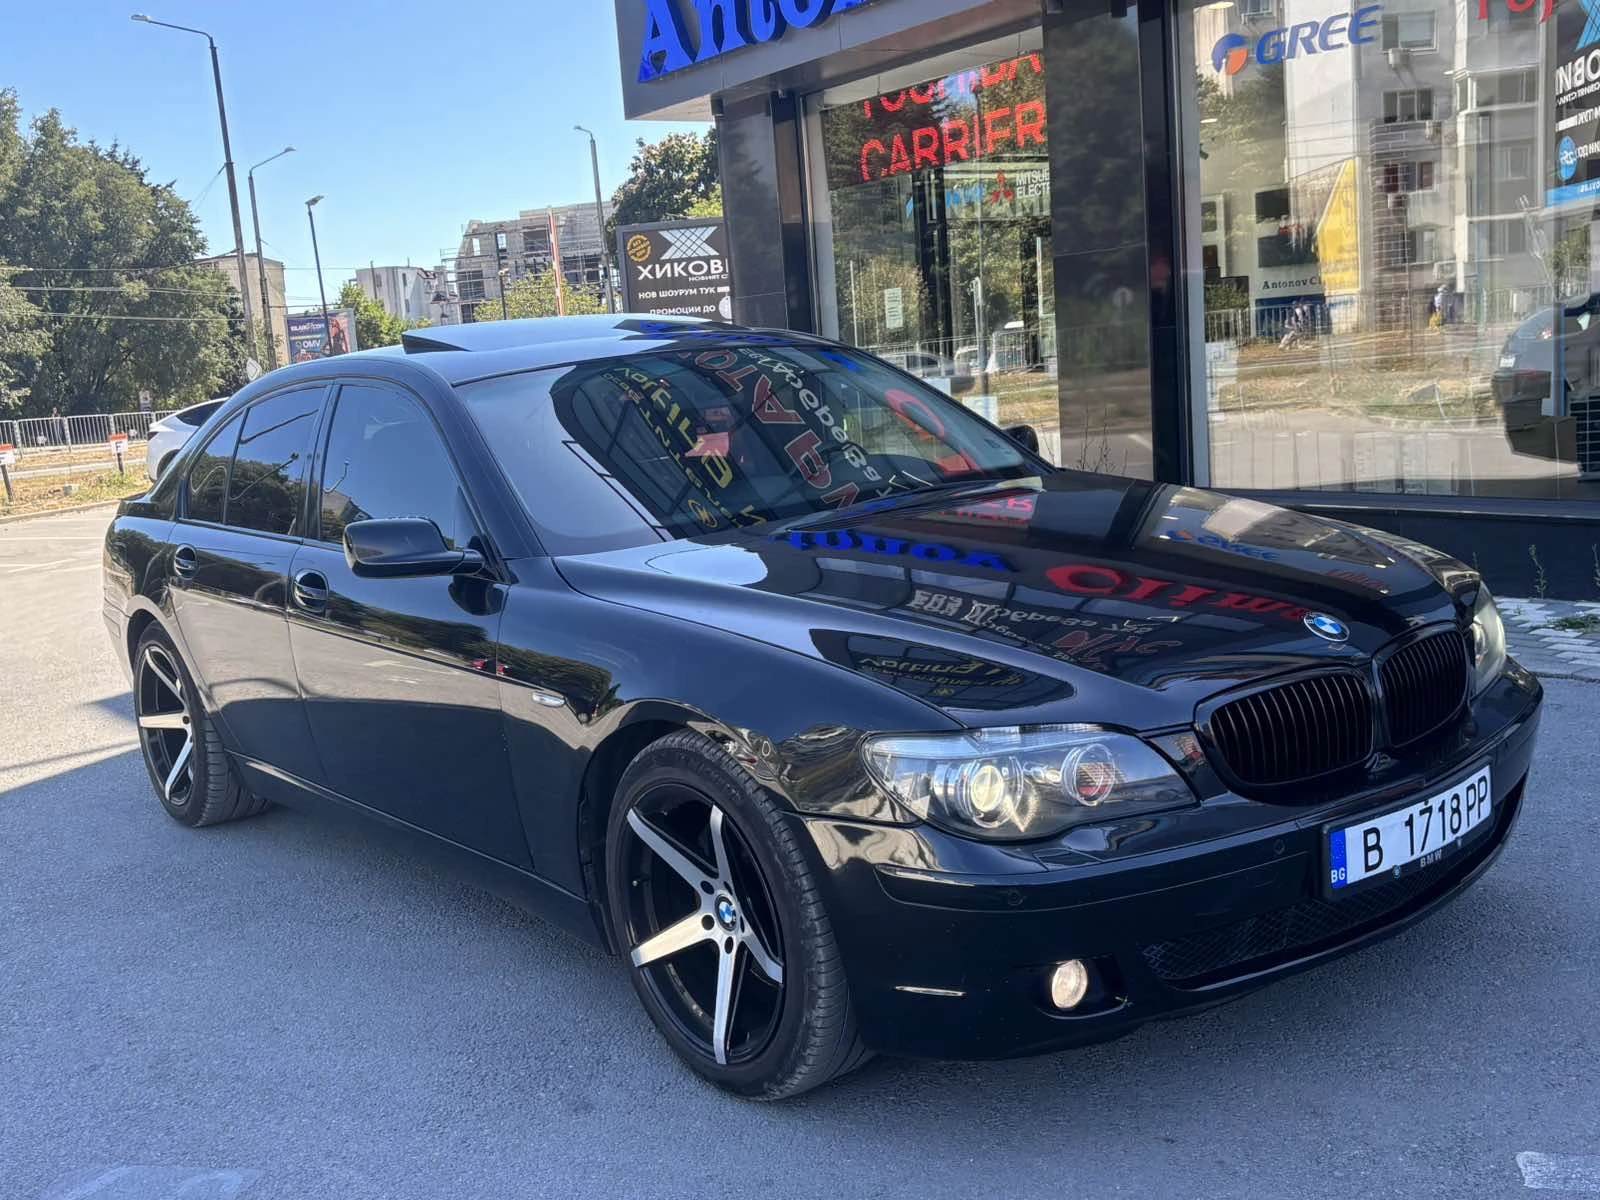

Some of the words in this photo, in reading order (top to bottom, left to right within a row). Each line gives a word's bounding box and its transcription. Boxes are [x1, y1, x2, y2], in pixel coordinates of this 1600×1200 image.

[1256, 4, 1384, 64] GREE
[637, 258, 728, 280] ХИКОВ
[1262, 278, 1308, 290] Antonov
[659, 288, 697, 298] ШОУРУМ
[702, 304, 717, 314] ДО
[1363, 826, 1384, 873] B
[1420, 849, 1443, 868] BMW
[1331, 868, 1346, 884] BG
